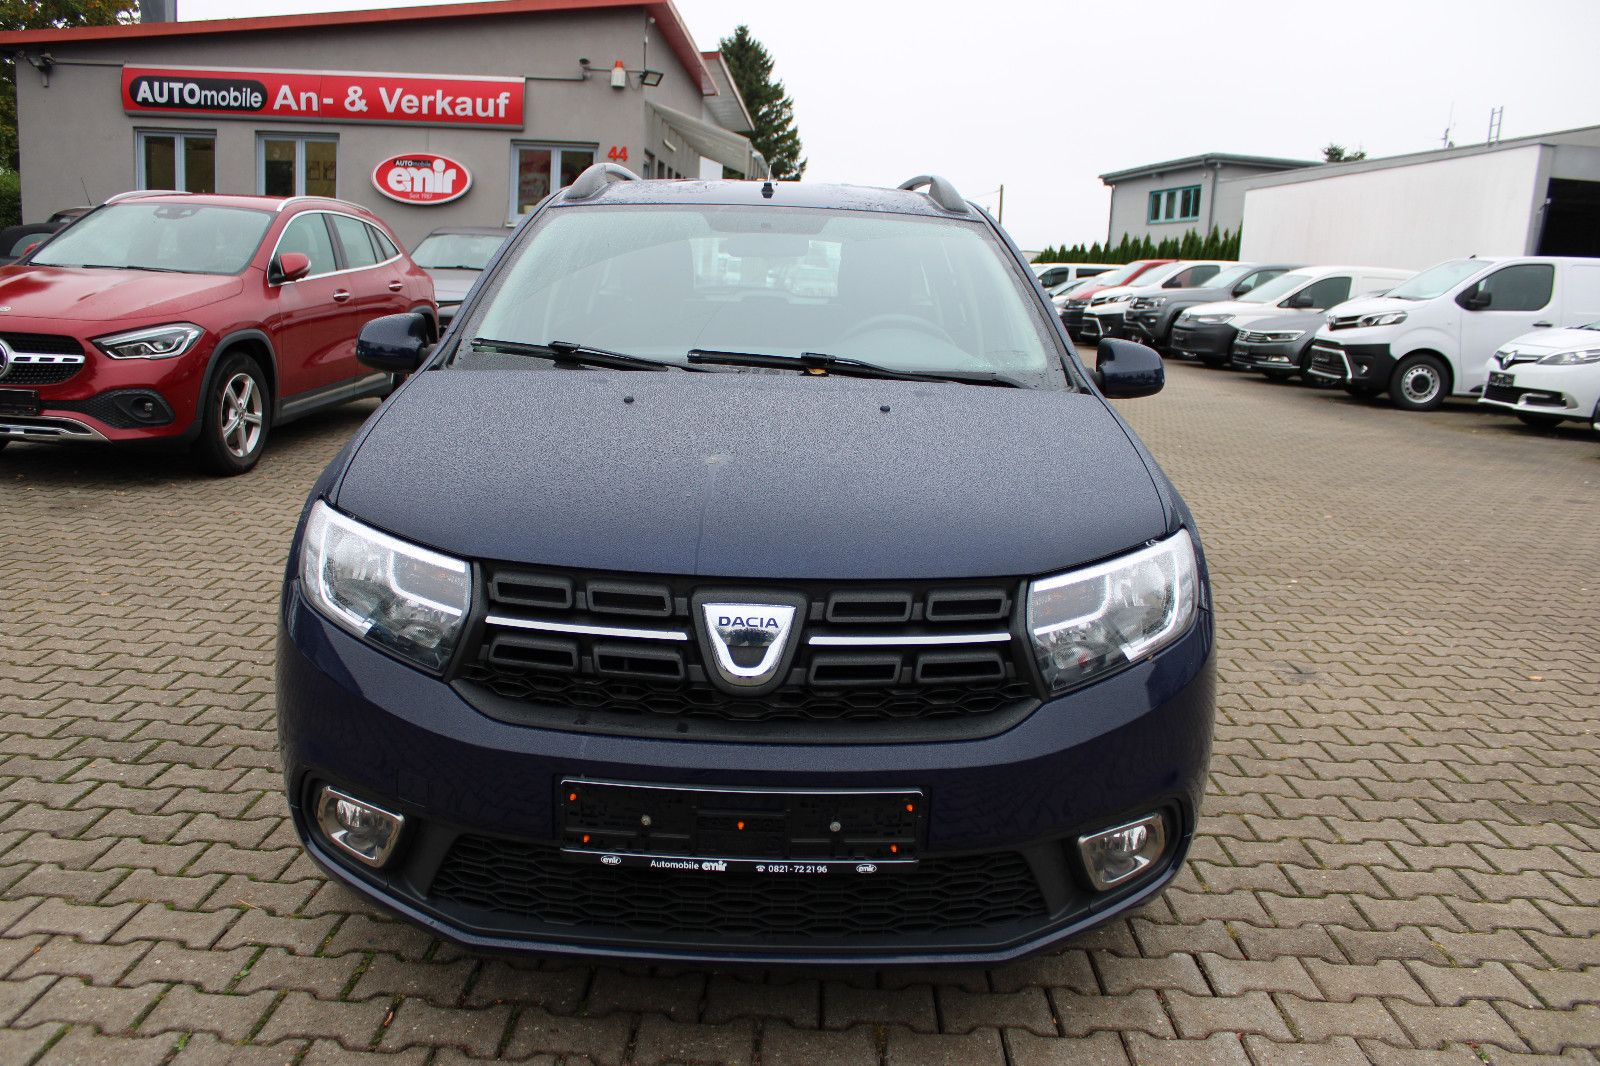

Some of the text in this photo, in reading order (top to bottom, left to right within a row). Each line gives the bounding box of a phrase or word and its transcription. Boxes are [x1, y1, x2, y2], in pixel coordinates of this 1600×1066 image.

[136, 80, 511, 118] AUTOmobile An- & Verkauf
[607, 145, 628, 161] 44
[387, 159, 457, 194] emir
[718, 616, 779, 629] DACIA
[650, 860, 727, 872] Automobile emir
